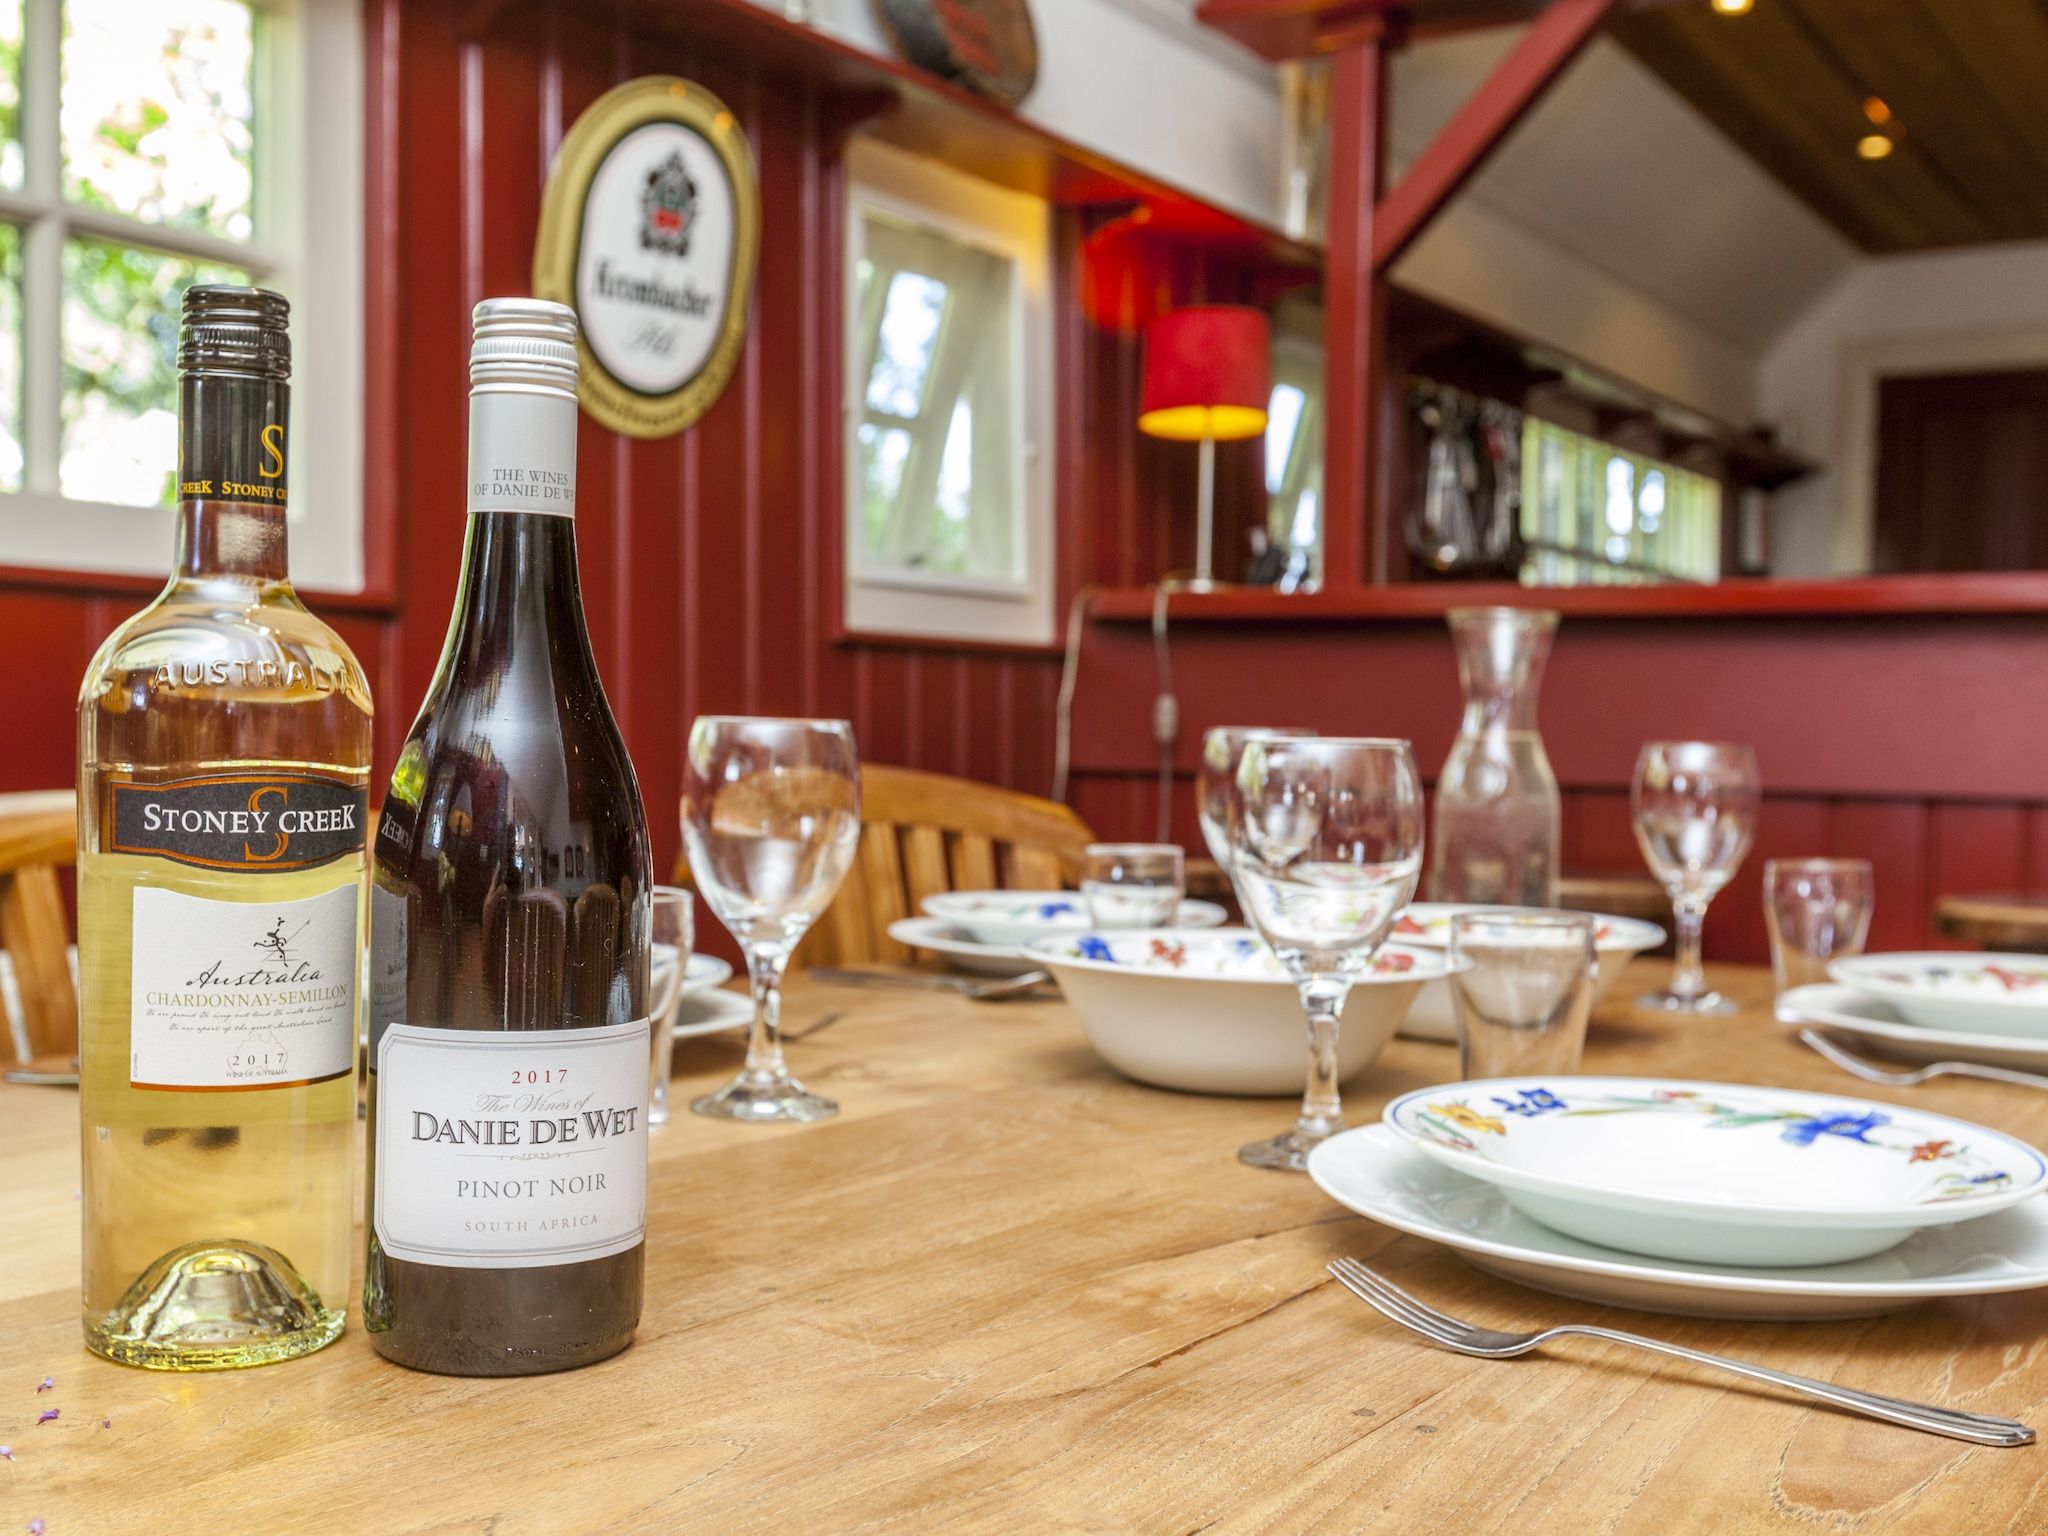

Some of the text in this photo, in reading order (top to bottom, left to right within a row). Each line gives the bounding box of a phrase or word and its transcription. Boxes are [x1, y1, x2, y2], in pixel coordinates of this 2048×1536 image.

[493, 468, 568, 486] THE WINES
[222, 481, 275, 498] STONEY
[474, 484, 488, 496] OF
[492, 484, 539, 497] DANIE
[544, 486, 560, 499] DE
[143, 803, 356, 834] STONEY CREEK
[186, 960, 324, 989] Australia
[146, 983, 348, 1008] CHARDONNAY-SEMILLON
[232, 1053, 284, 1066] 2017
[512, 1069, 568, 1084] 2017
[472, 1089, 595, 1115] The Wines of
[412, 1106, 638, 1145] DANIE DE WET
[456, 1173, 607, 1199] PINOT NOIR
[464, 1213, 601, 1233] SOUTH AFRICA
